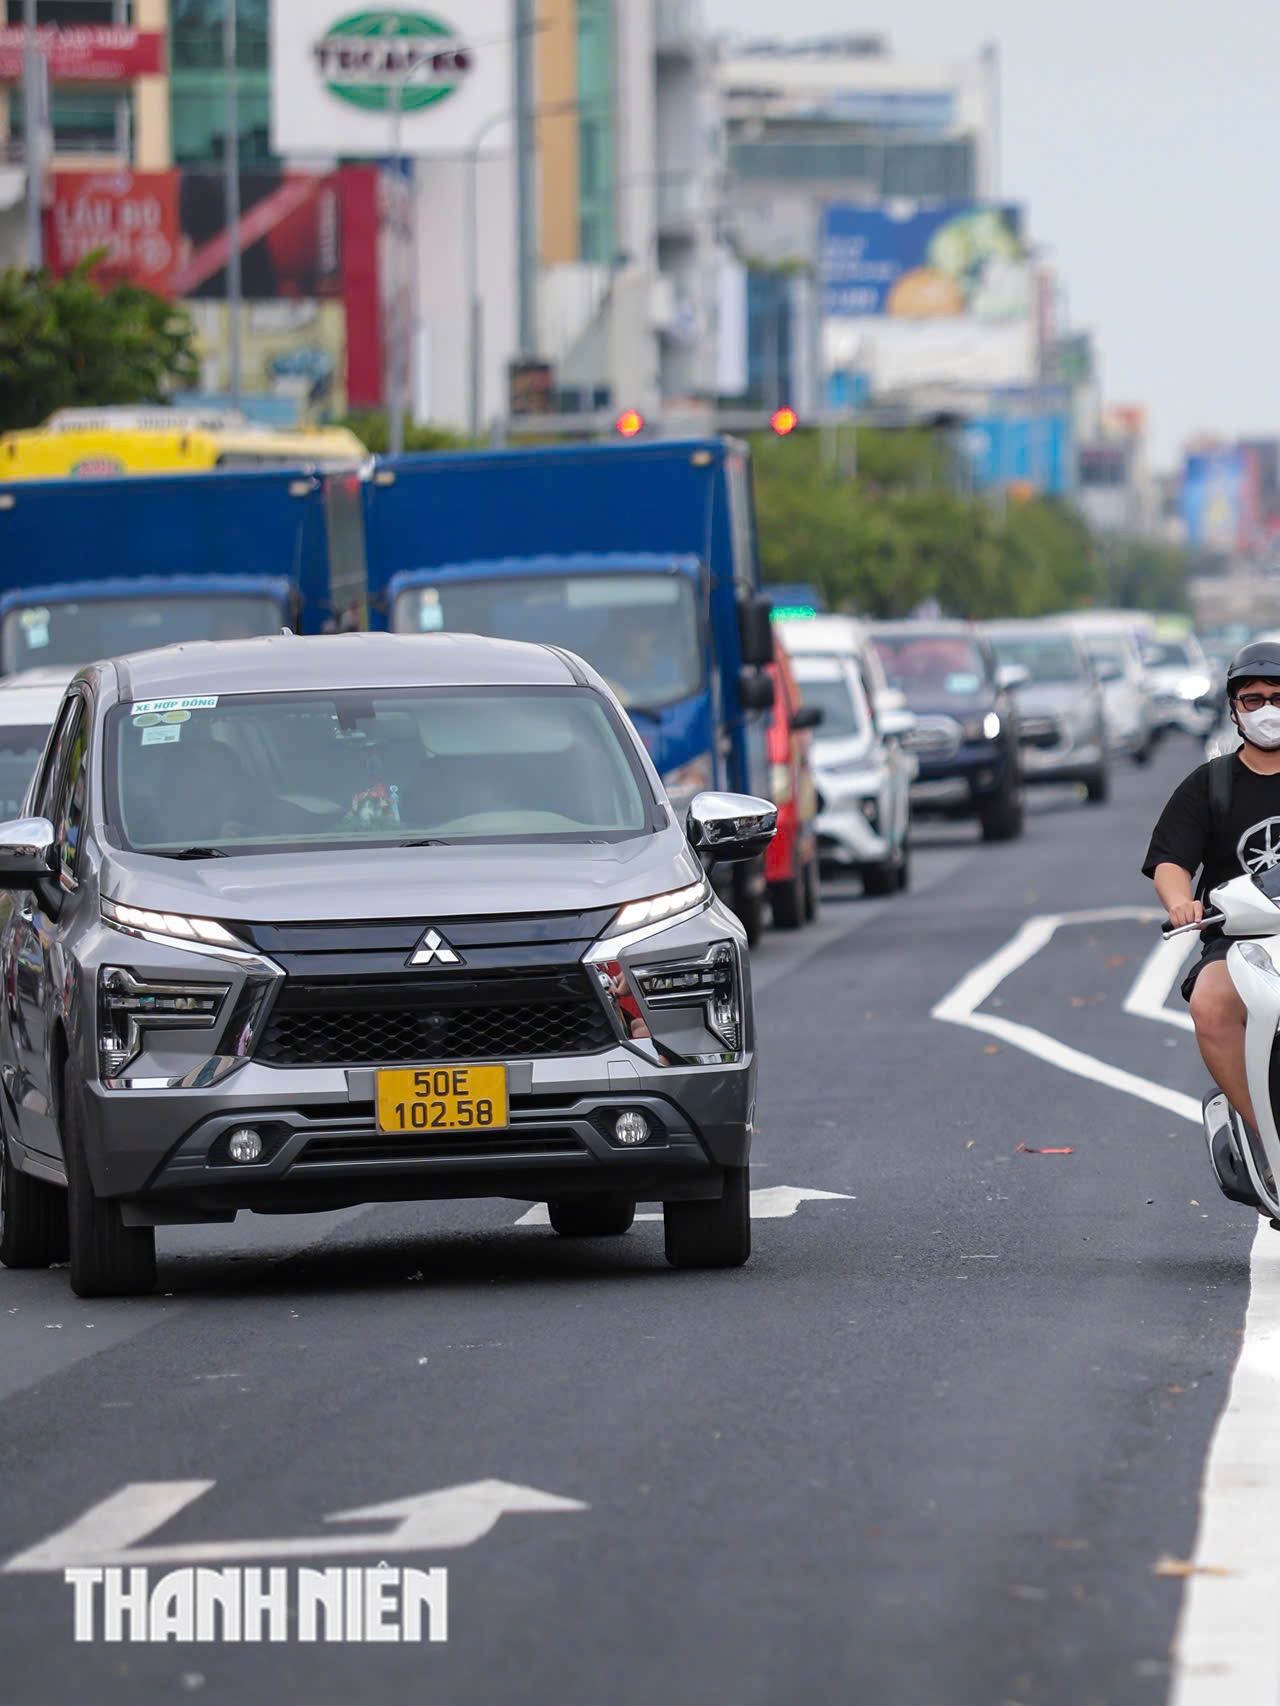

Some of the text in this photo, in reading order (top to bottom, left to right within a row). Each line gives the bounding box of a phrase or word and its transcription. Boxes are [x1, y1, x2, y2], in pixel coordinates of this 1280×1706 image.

[136, 704, 151, 712] XE
[414, 1070, 469, 1098] 50E
[395, 1099, 493, 1129] 102.58
